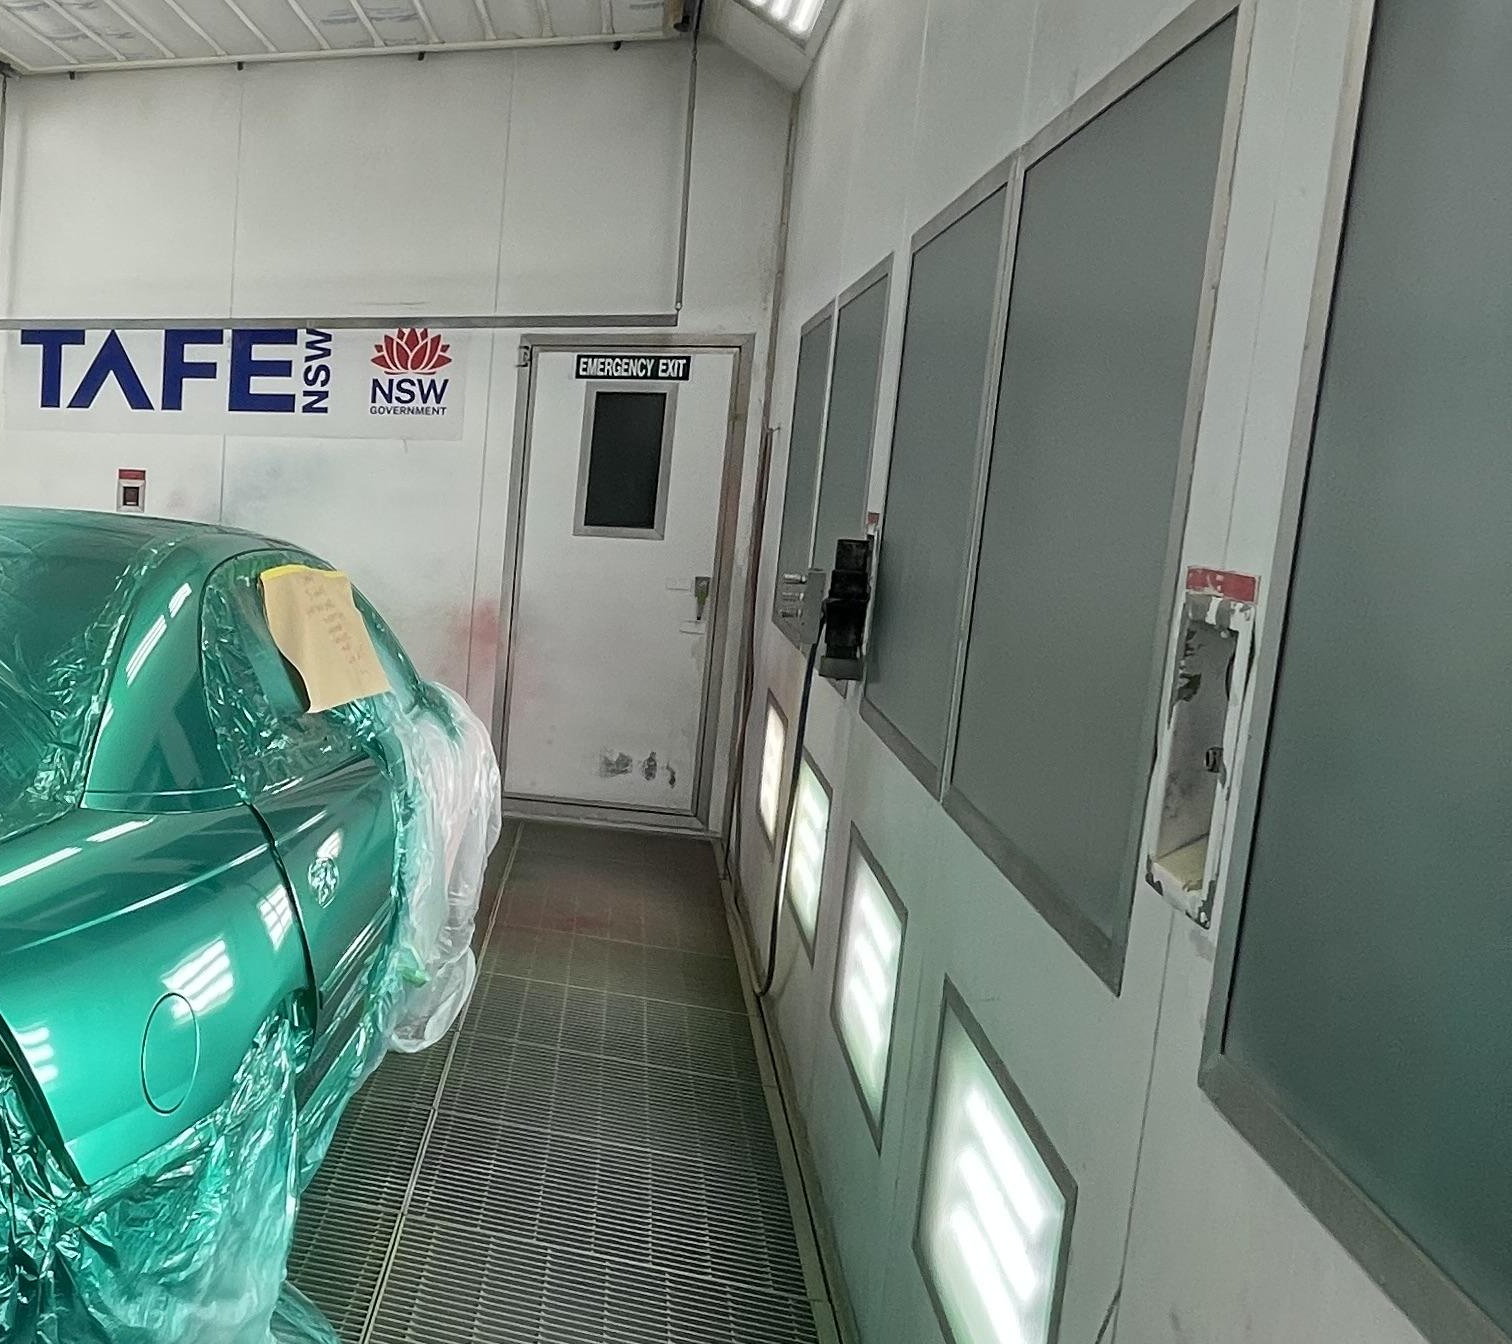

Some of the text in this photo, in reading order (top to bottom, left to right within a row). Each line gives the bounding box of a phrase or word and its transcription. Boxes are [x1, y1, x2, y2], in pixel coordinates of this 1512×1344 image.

[20, 327, 333, 414] TAFE NSW
[579, 358, 687, 377] EMERGENCY EXIT
[370, 378, 449, 405] NSW
[369, 406, 447, 416] GOVERNMENT
